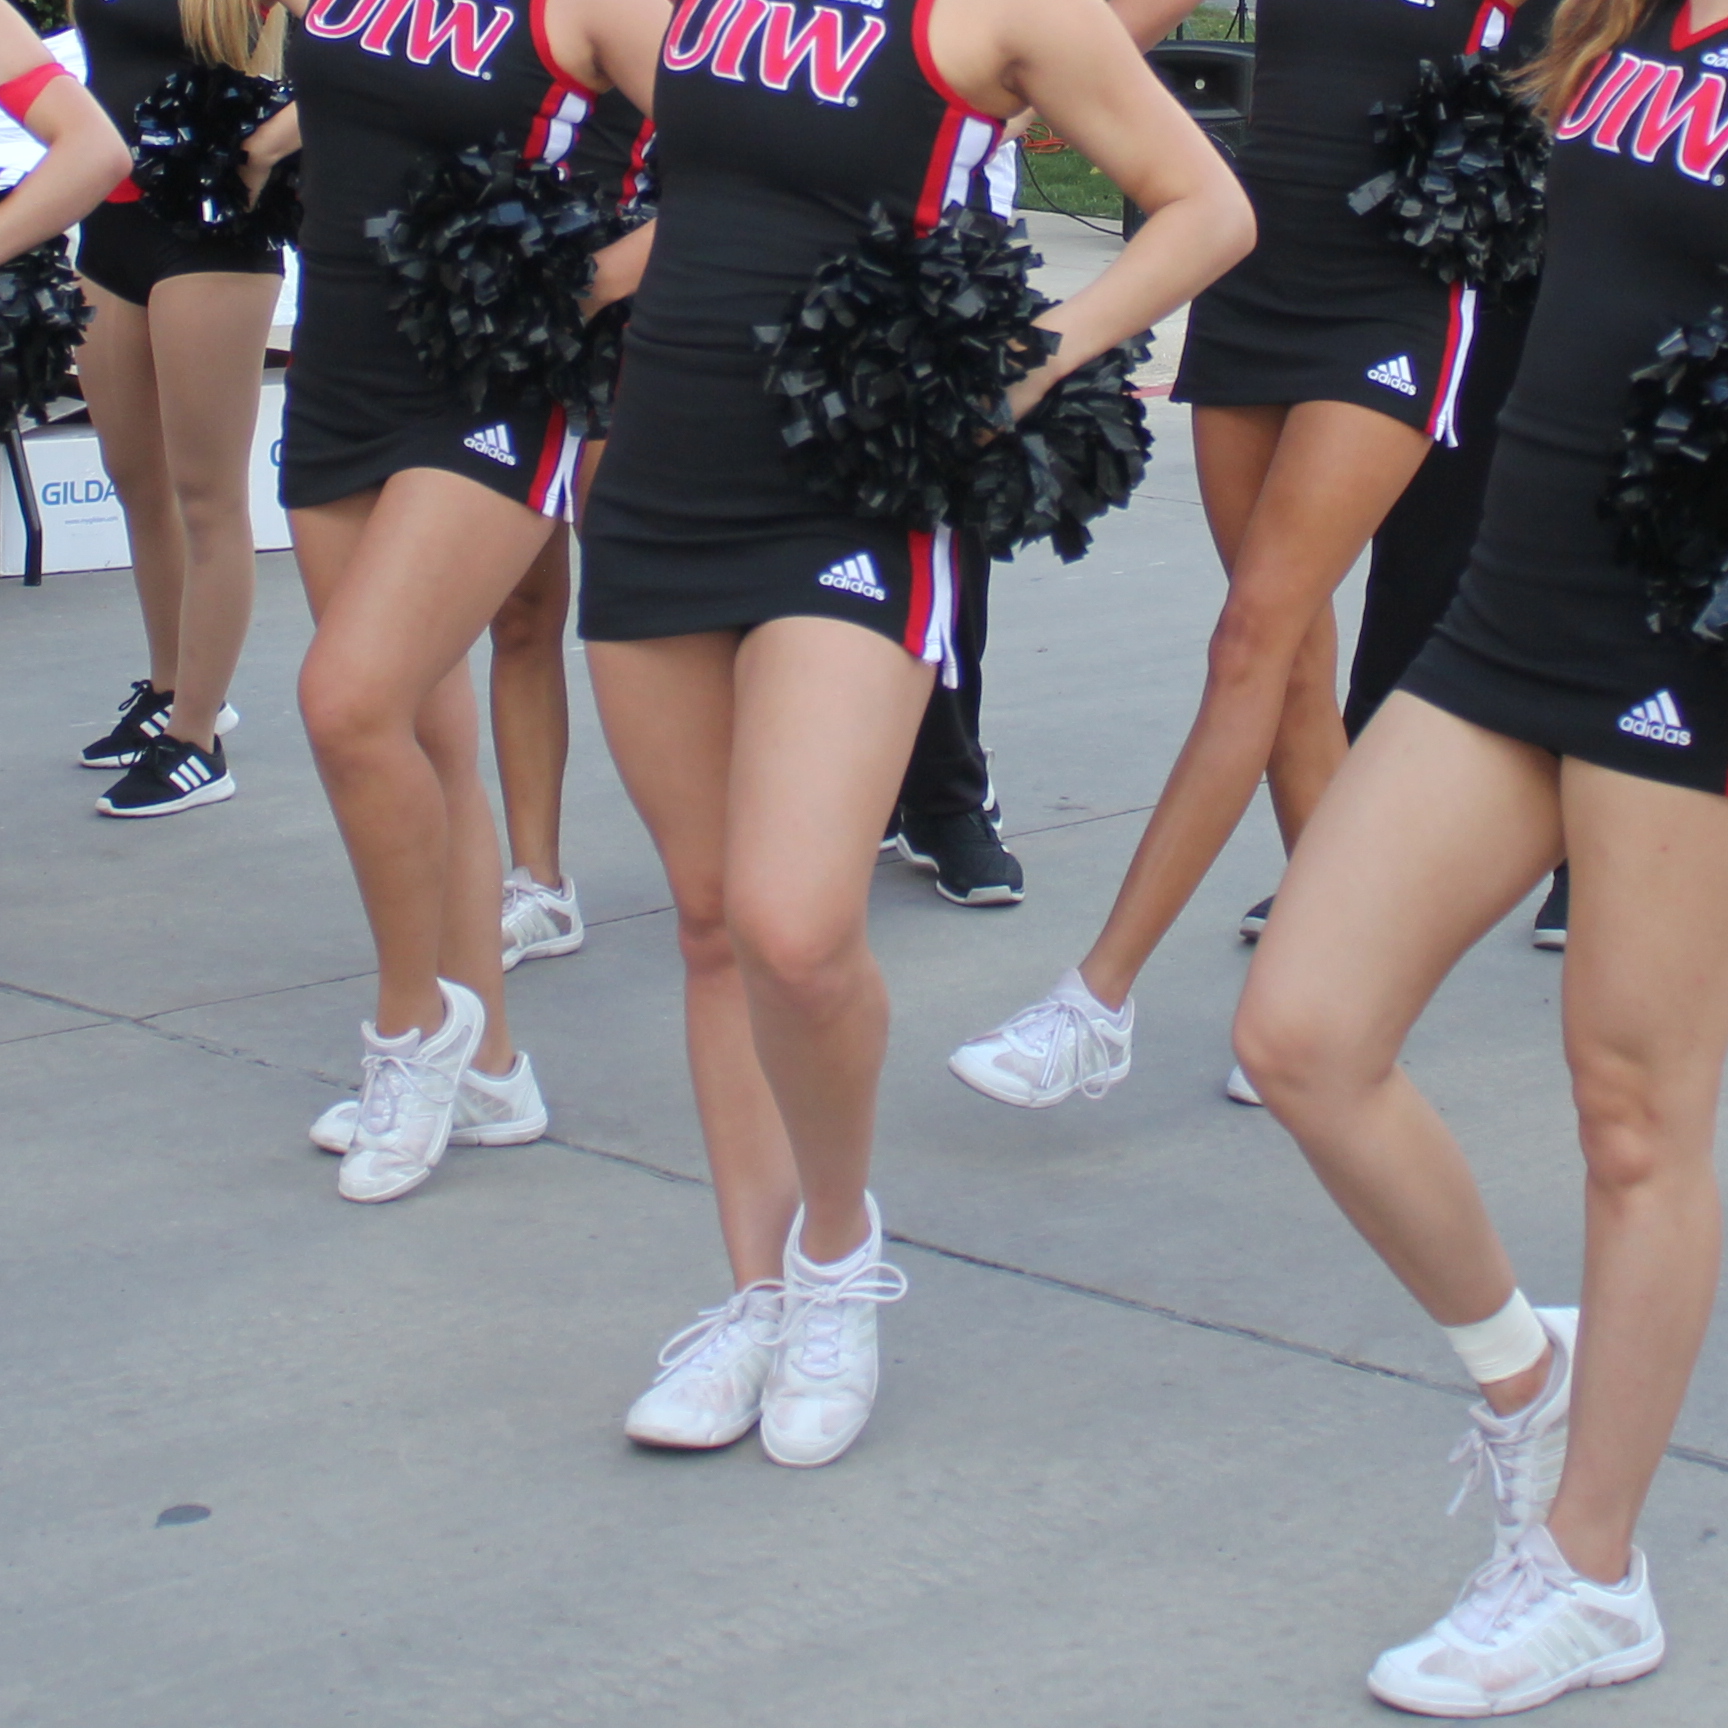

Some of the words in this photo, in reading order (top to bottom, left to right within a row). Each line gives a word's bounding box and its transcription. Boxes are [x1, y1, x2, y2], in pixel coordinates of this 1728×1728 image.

[1367, 369, 1417, 396] adidas
[463, 437, 516, 466] adidas
[41, 480, 117, 505] GILDA
[819, 574, 885, 601] adidas
[1620, 716, 1691, 746] adidas
